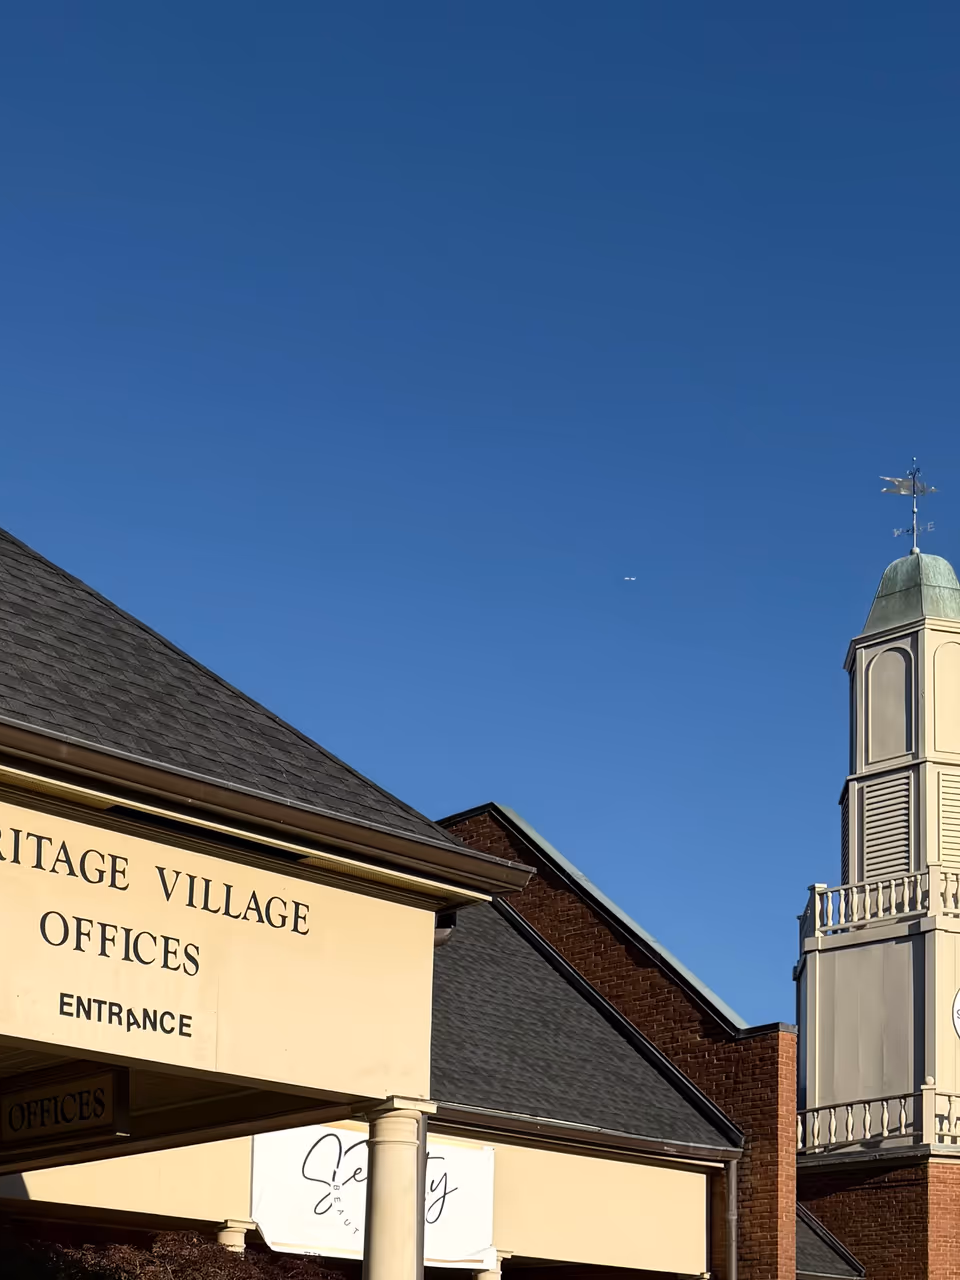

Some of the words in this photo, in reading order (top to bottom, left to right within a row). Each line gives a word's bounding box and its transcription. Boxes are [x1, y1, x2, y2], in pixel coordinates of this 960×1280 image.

[155, 865, 310, 936] VILLAGE
[40, 910, 200, 976] OFFICES
[59, 992, 193, 1038] ENTRANCE
[8, 1087, 106, 1132] OFFICES
